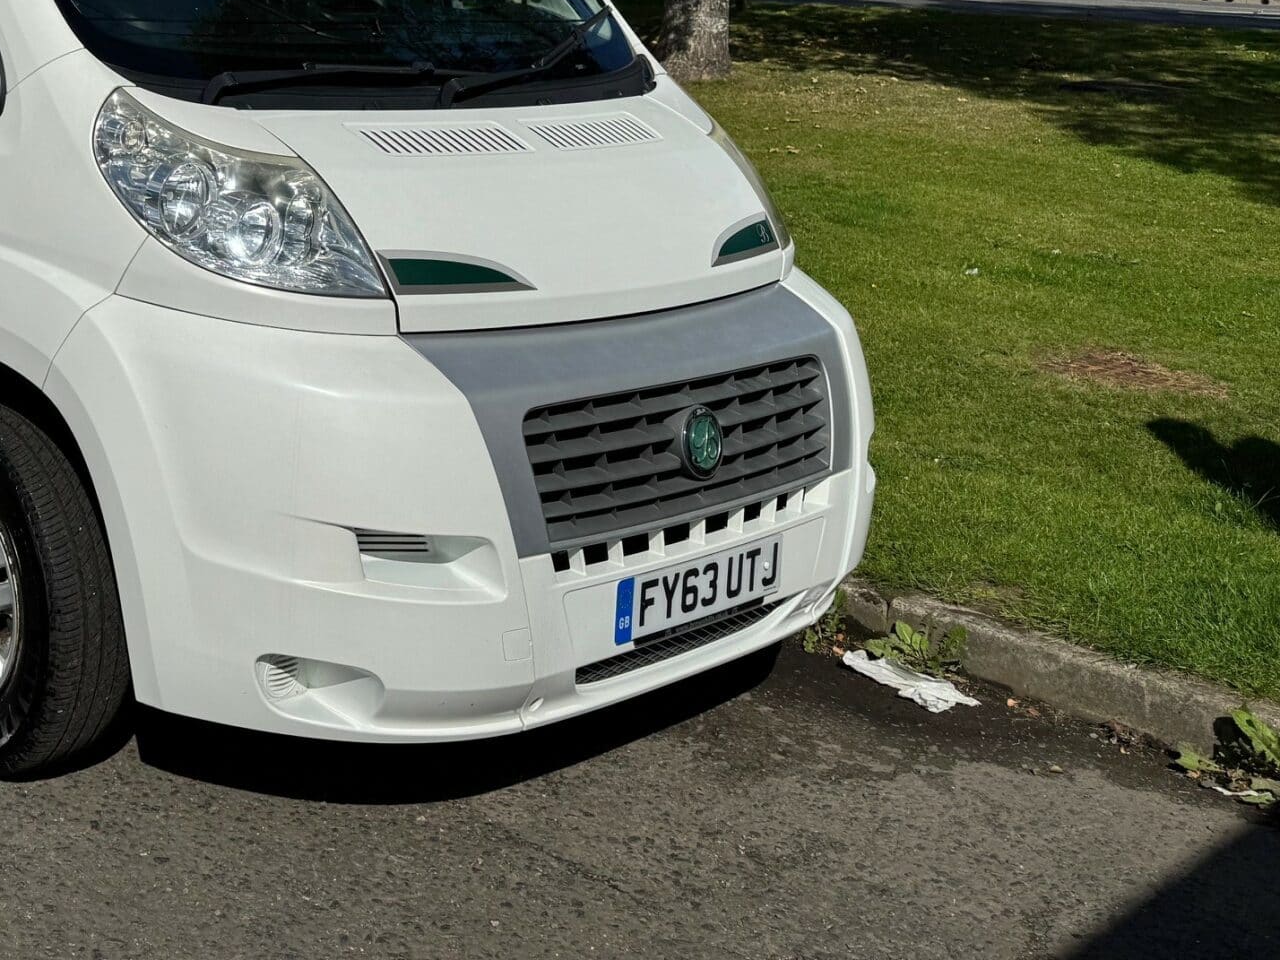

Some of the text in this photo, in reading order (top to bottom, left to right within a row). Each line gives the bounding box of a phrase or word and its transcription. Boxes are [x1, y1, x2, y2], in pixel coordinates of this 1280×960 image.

[639, 542, 779, 627] FY63 UTJ
[619, 615, 630, 629] GB
